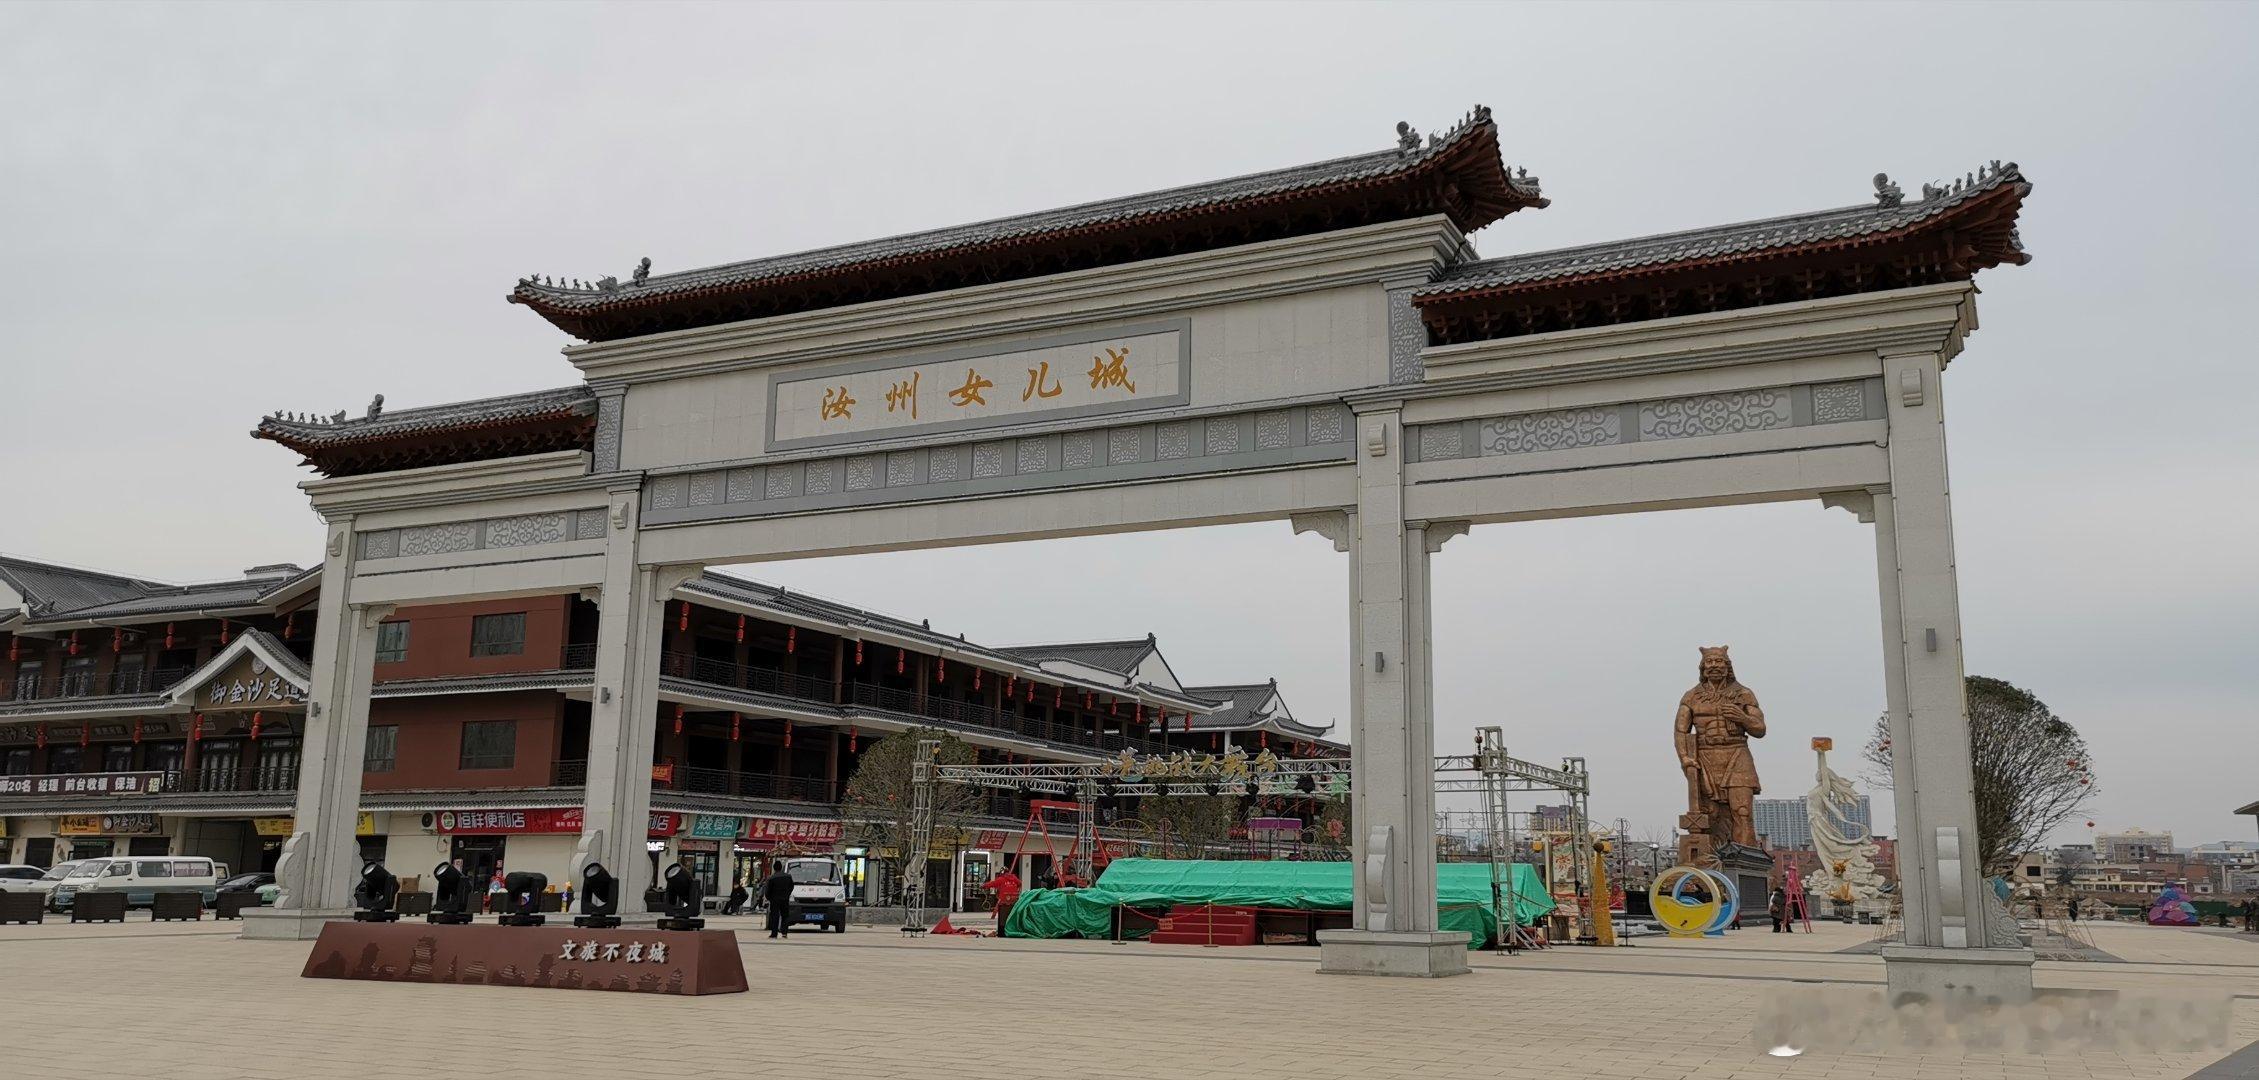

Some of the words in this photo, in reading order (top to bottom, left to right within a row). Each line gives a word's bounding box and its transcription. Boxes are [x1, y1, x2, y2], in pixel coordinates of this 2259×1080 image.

[821, 348, 1136, 420] 汝州女儿城
[210, 678, 301, 704] 御金沙足道
[38, 778, 59, 792] 经理
[115, 777, 136, 791] 保洁
[457, 812, 525, 828] 恒祥便利店
[559, 940, 666, 963] 文旅不夜城
